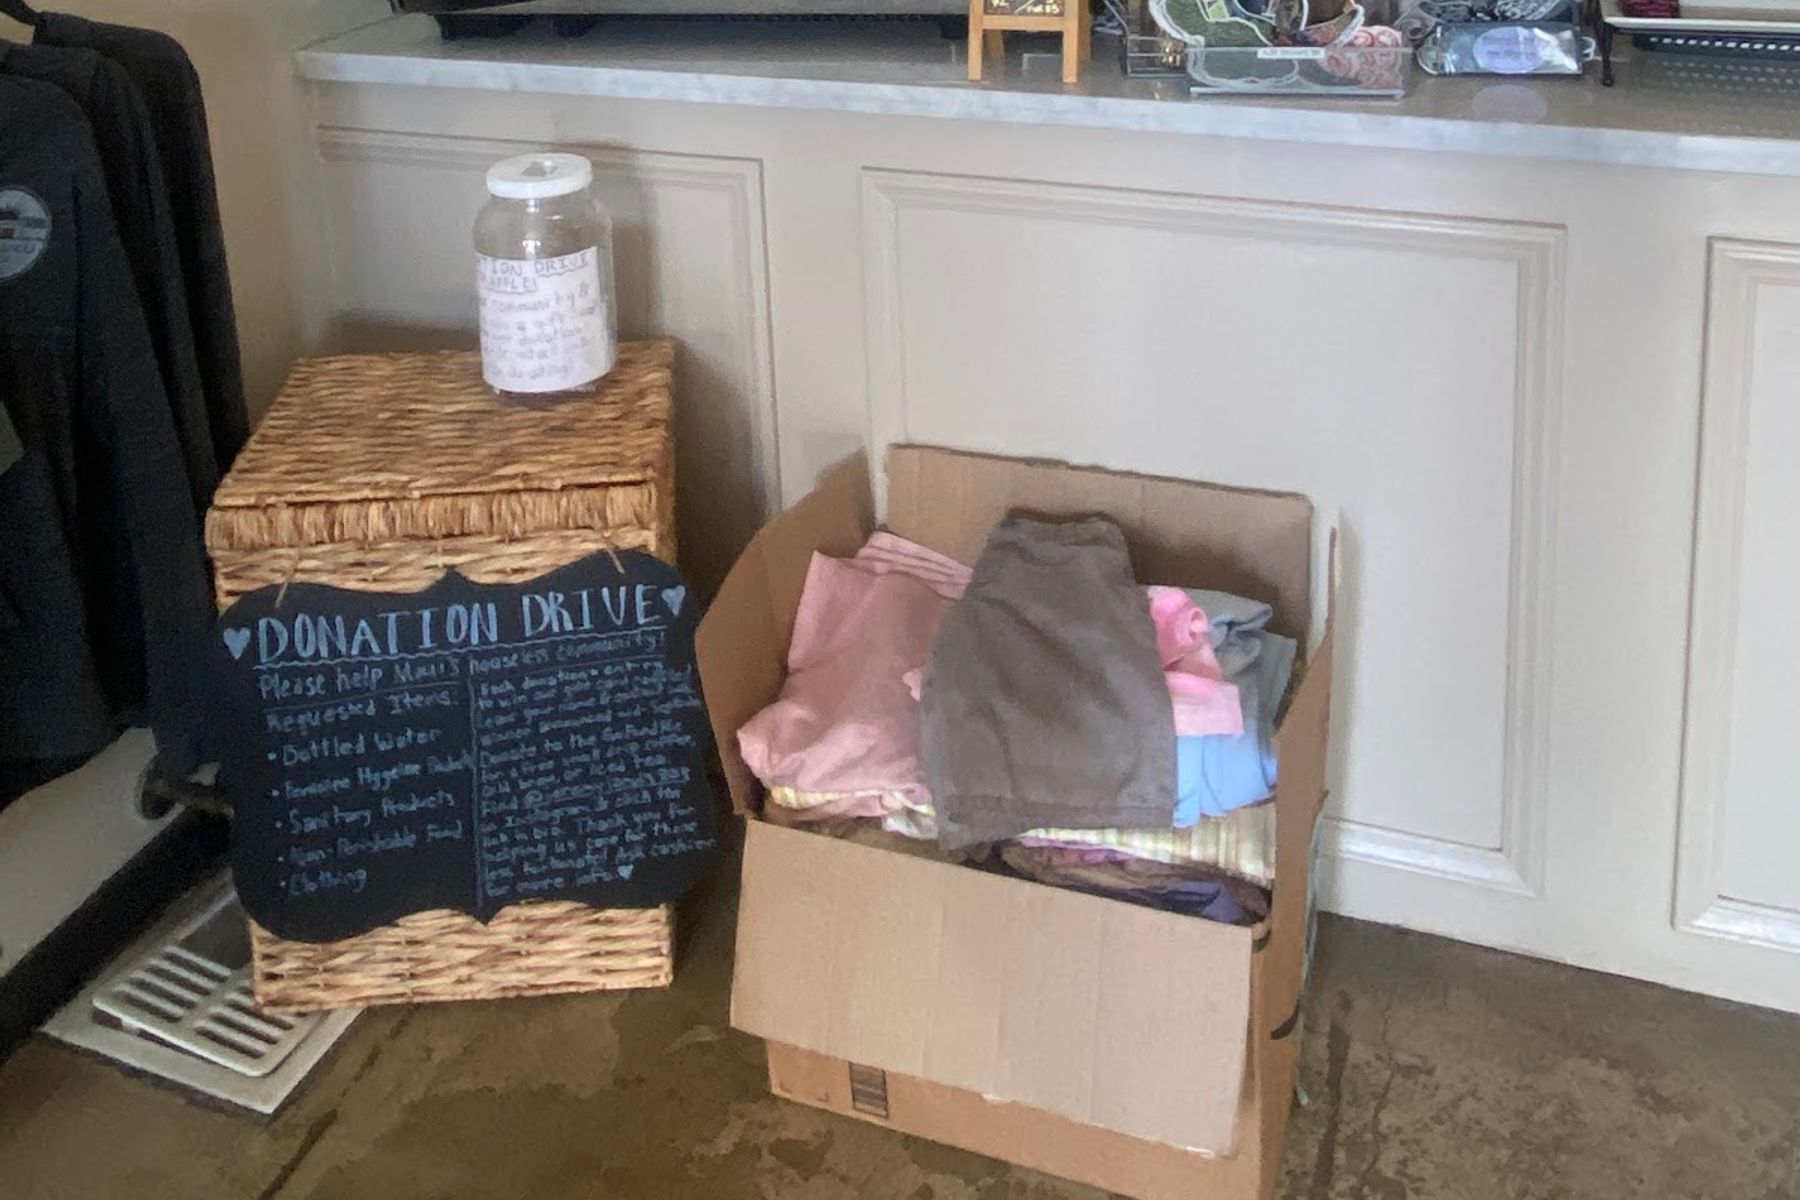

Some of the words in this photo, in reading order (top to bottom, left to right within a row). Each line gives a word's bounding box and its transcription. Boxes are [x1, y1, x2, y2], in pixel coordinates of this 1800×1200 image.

[256, 601, 499, 664] DONATION
[521, 583, 662, 638] DRIVE
[258, 671, 326, 700] Please
[336, 664, 384, 692] help
[282, 731, 366, 767] Bottled
[373, 726, 442, 752] Water
